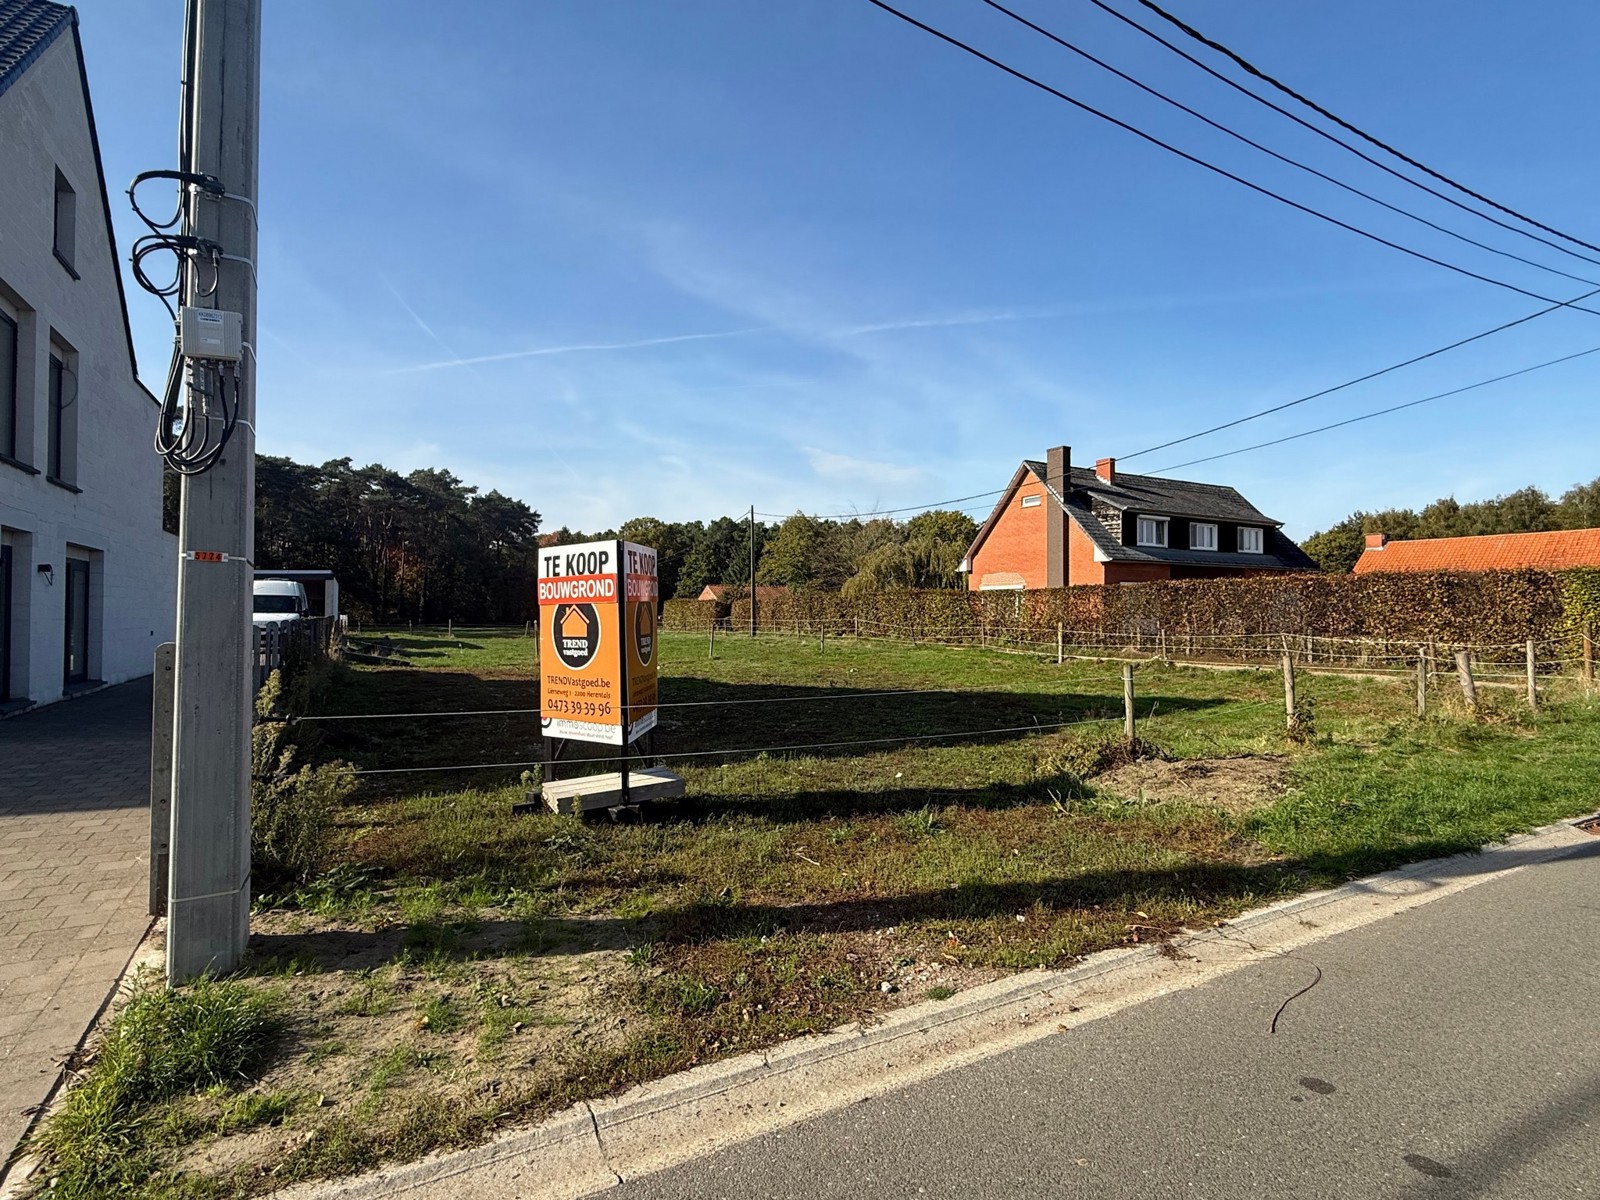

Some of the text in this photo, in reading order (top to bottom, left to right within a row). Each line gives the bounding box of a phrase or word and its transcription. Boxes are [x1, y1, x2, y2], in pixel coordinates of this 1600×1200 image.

[544, 551, 609, 577] TE KOOP
[628, 550, 655, 575] TE KOOP
[540, 579, 614, 599] BOUWGROND
[562, 639, 588, 648] TREND
[547, 675, 611, 689] TRENDVastgoed.be
[547, 699, 611, 717] 0473 39 39 96
